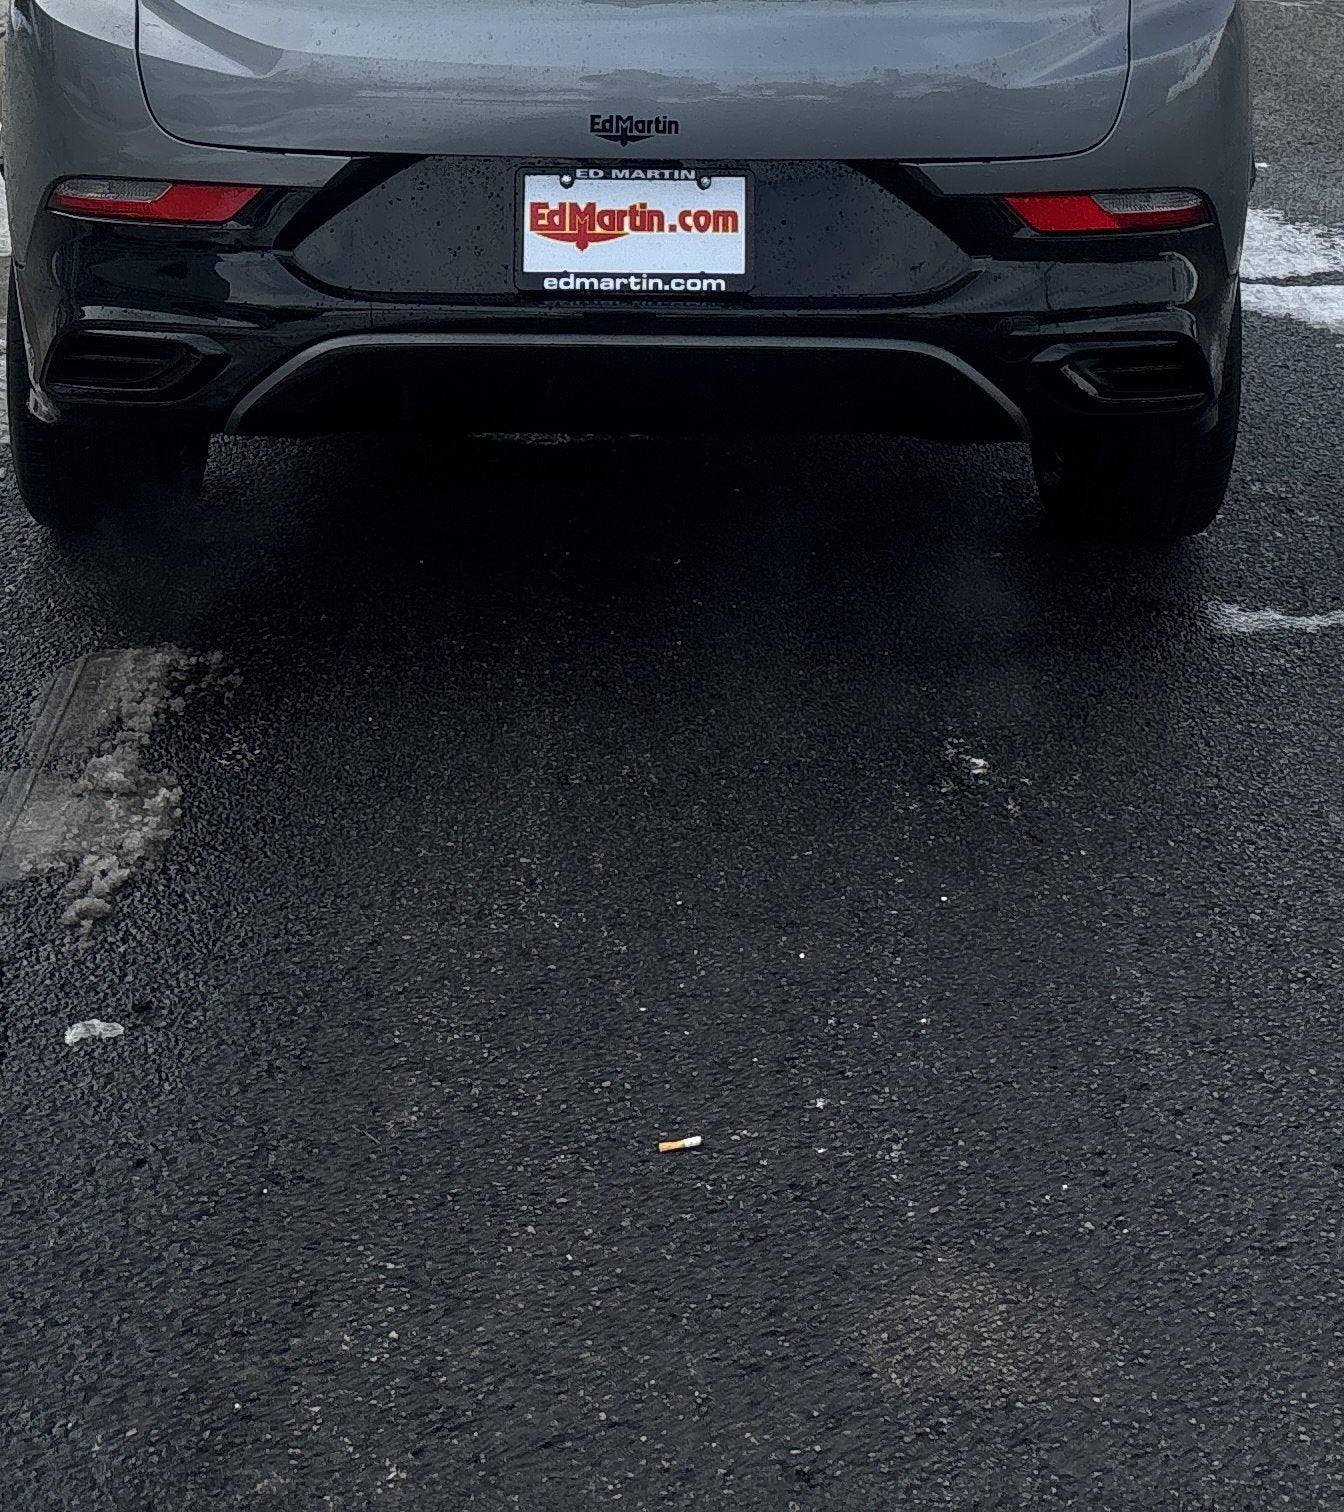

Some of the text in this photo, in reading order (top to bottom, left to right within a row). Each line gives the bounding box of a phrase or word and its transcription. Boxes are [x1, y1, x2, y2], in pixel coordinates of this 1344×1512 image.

[576, 169, 696, 180] ED MARTIN
[543, 274, 726, 291] edmartin.com
